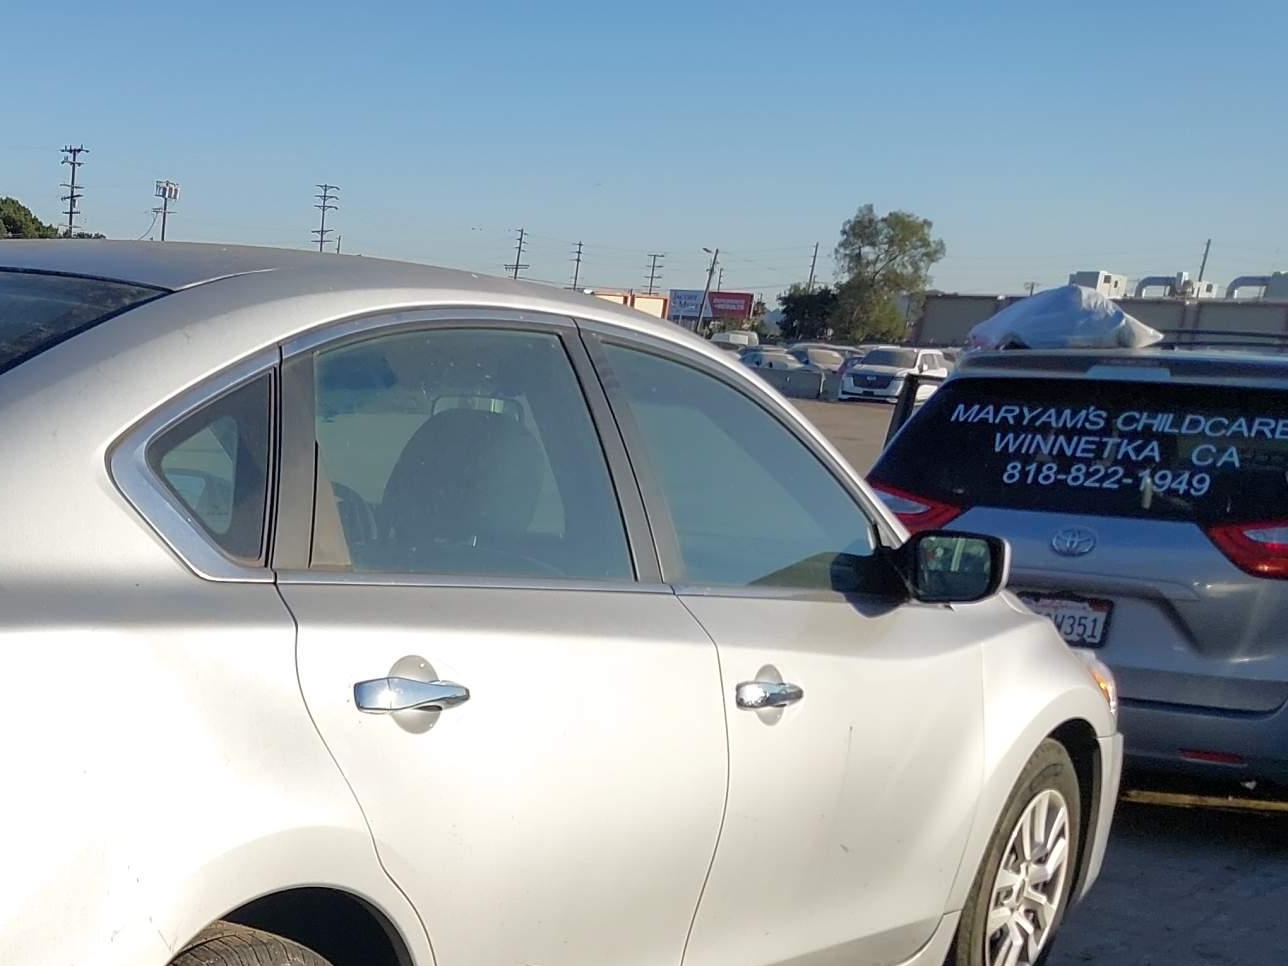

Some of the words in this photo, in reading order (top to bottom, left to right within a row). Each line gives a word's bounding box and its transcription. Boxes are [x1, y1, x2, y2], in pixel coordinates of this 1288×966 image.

[951, 404, 1108, 430] MARYAM'S
[994, 433, 1160, 463] WINNETKA
[1191, 444, 1240, 468] CA
[1003, 462, 1210, 496] 818-822-1949
